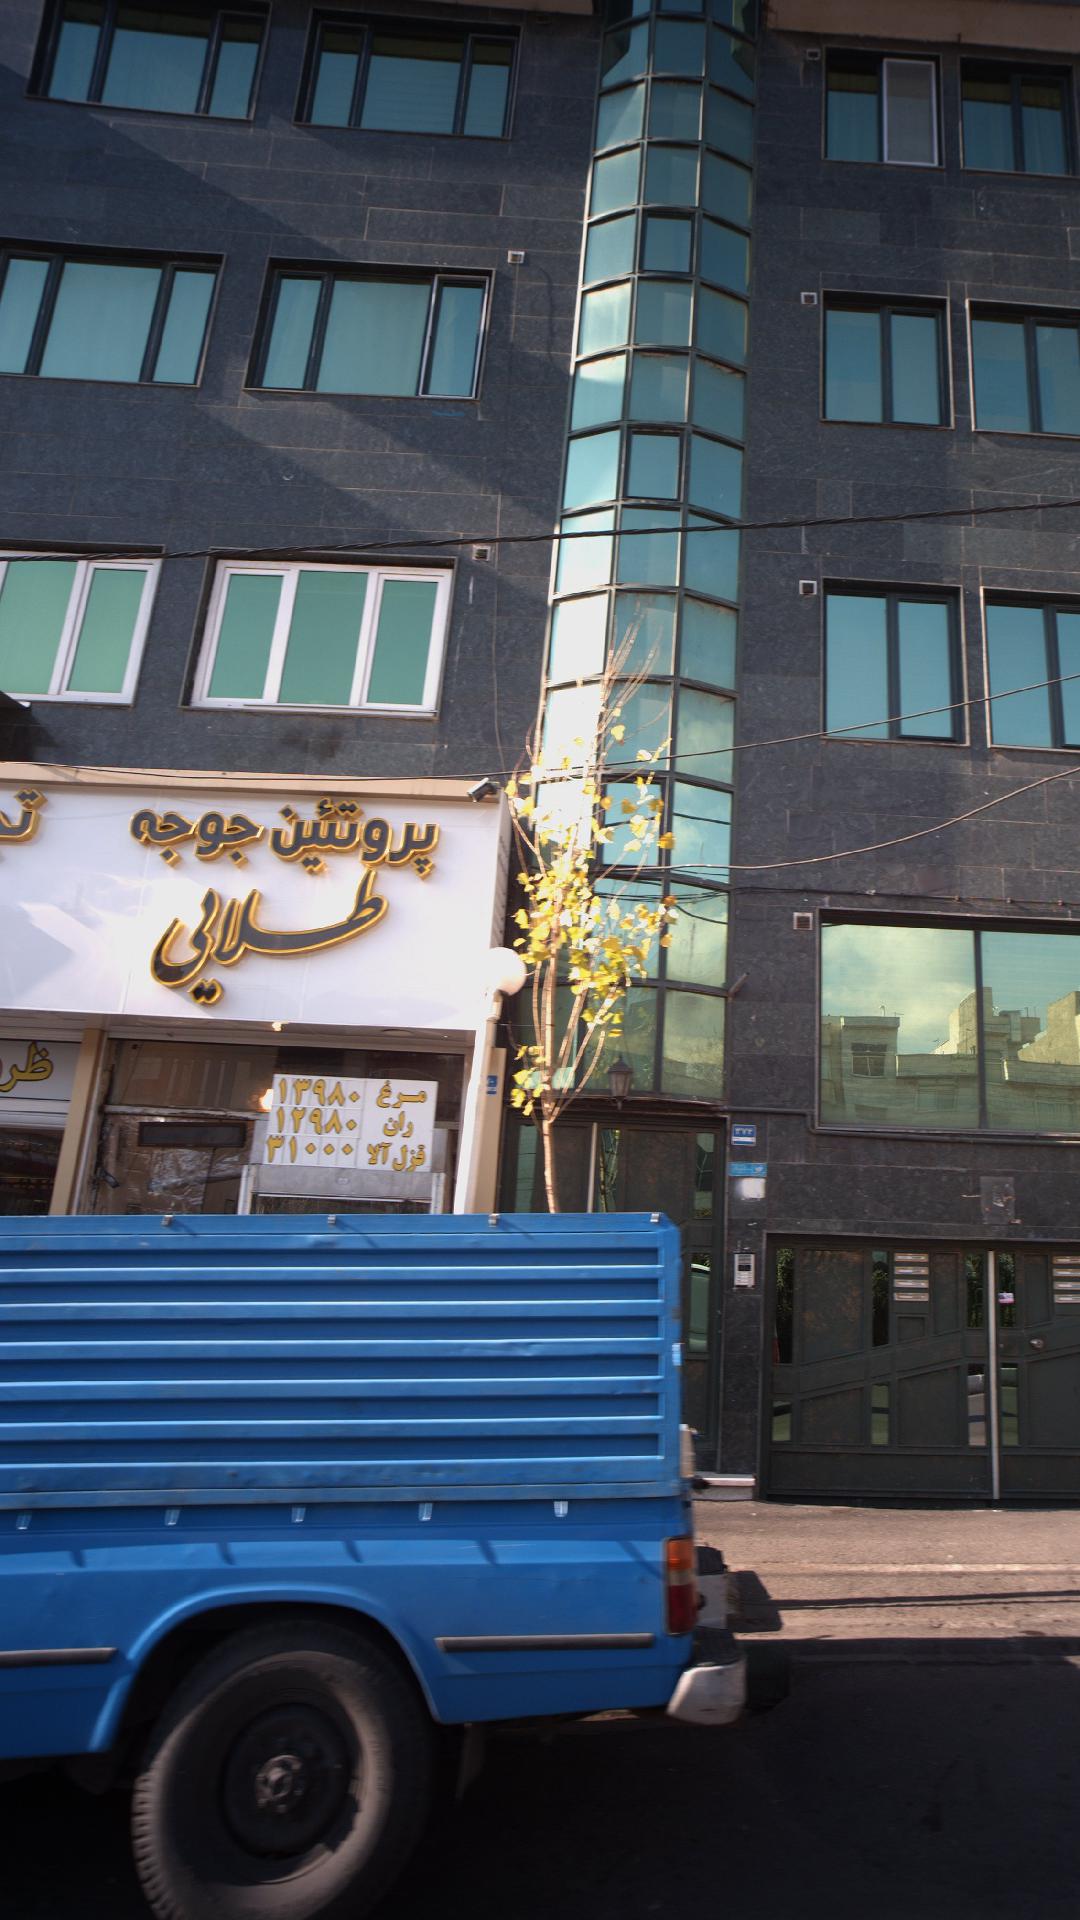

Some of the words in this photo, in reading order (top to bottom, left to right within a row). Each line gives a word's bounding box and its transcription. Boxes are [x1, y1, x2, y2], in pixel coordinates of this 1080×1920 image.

[129, 808, 265, 868] جوجه
[269, 796, 441, 881] پروتئین
[278, 1077, 361, 1107] ۱۳۹۸۰
[376, 1079, 428, 1109] مرغ
[276, 1106, 358, 1135] ۱۲۹۸۰
[383, 1110, 414, 1138] ران
[266, 1134, 354, 1163] ۳۱۰۰۰
[366, 1141, 392, 1165] آلا
[392, 1143, 426, 1172] قزل
